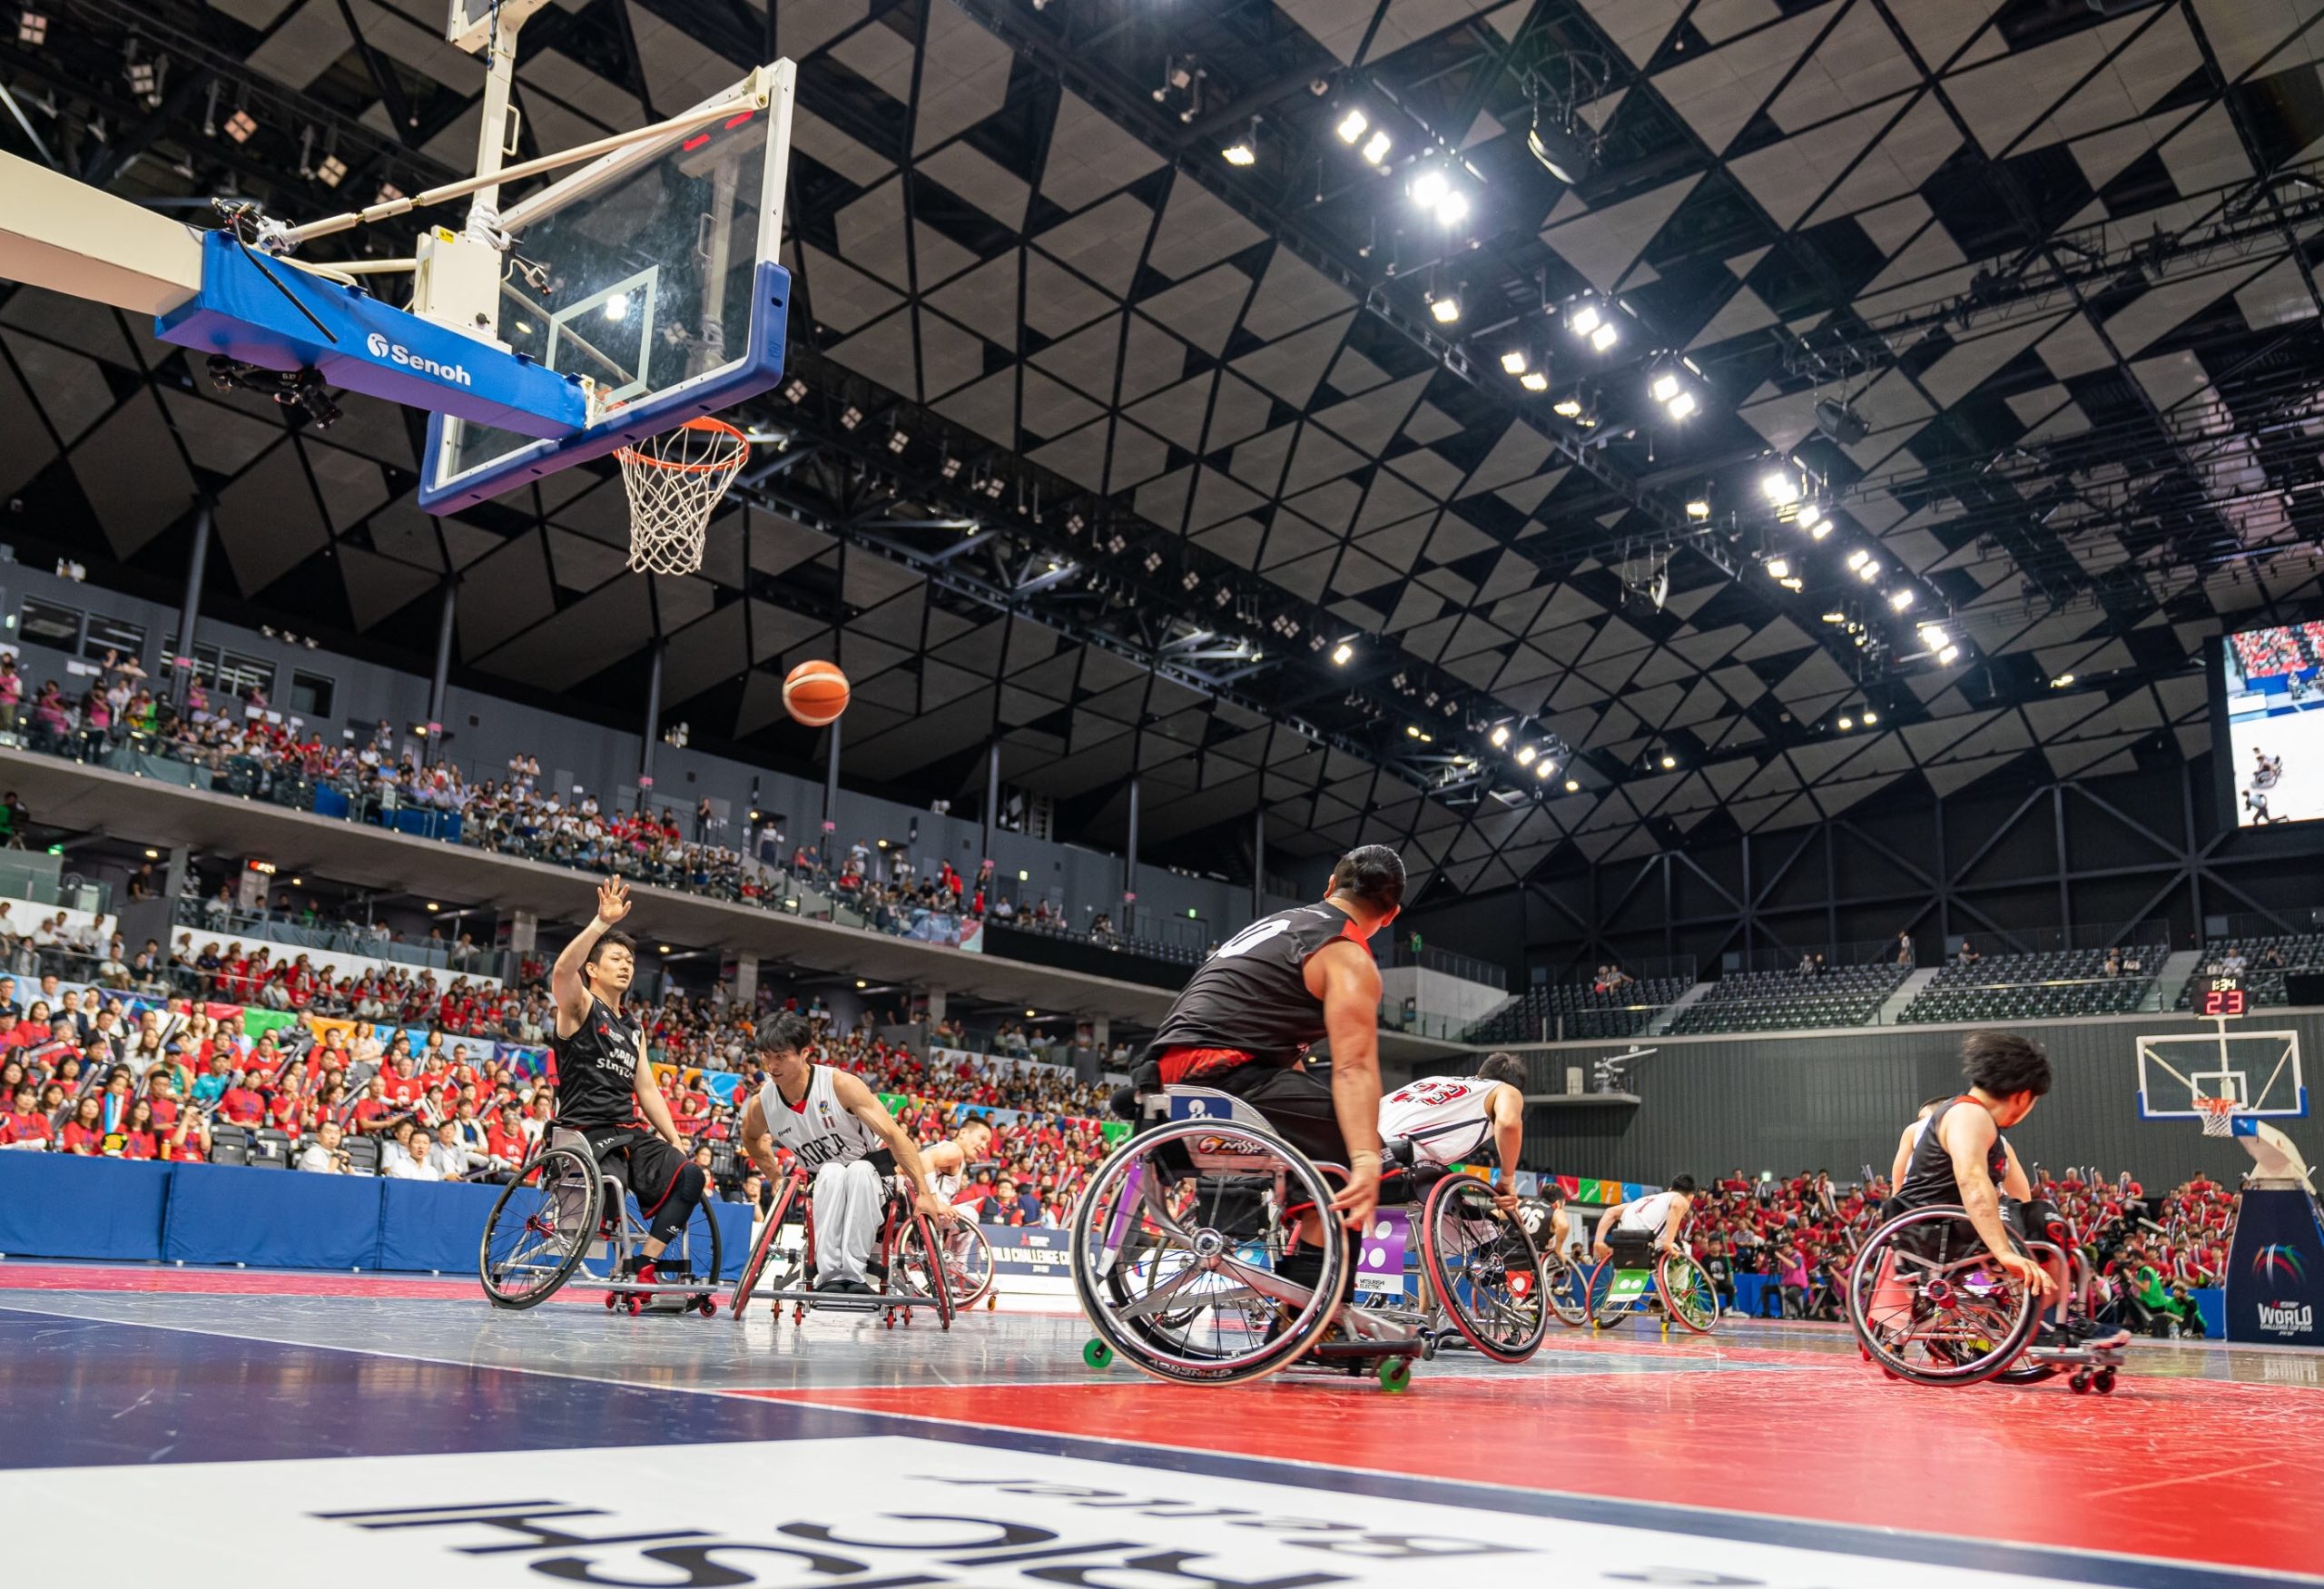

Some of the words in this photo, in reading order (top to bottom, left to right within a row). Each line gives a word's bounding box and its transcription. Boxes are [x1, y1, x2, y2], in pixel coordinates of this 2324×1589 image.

[391, 344, 471, 386] Senoh
[2211, 978, 2236, 992] 1:34
[2207, 991, 2243, 1014] 23
[596, 1058, 635, 1080] SUNTO
[822, 1116, 836, 1130] 11
[792, 1133, 852, 1167] KOREA
[2258, 1302, 2313, 1326] WORLD
